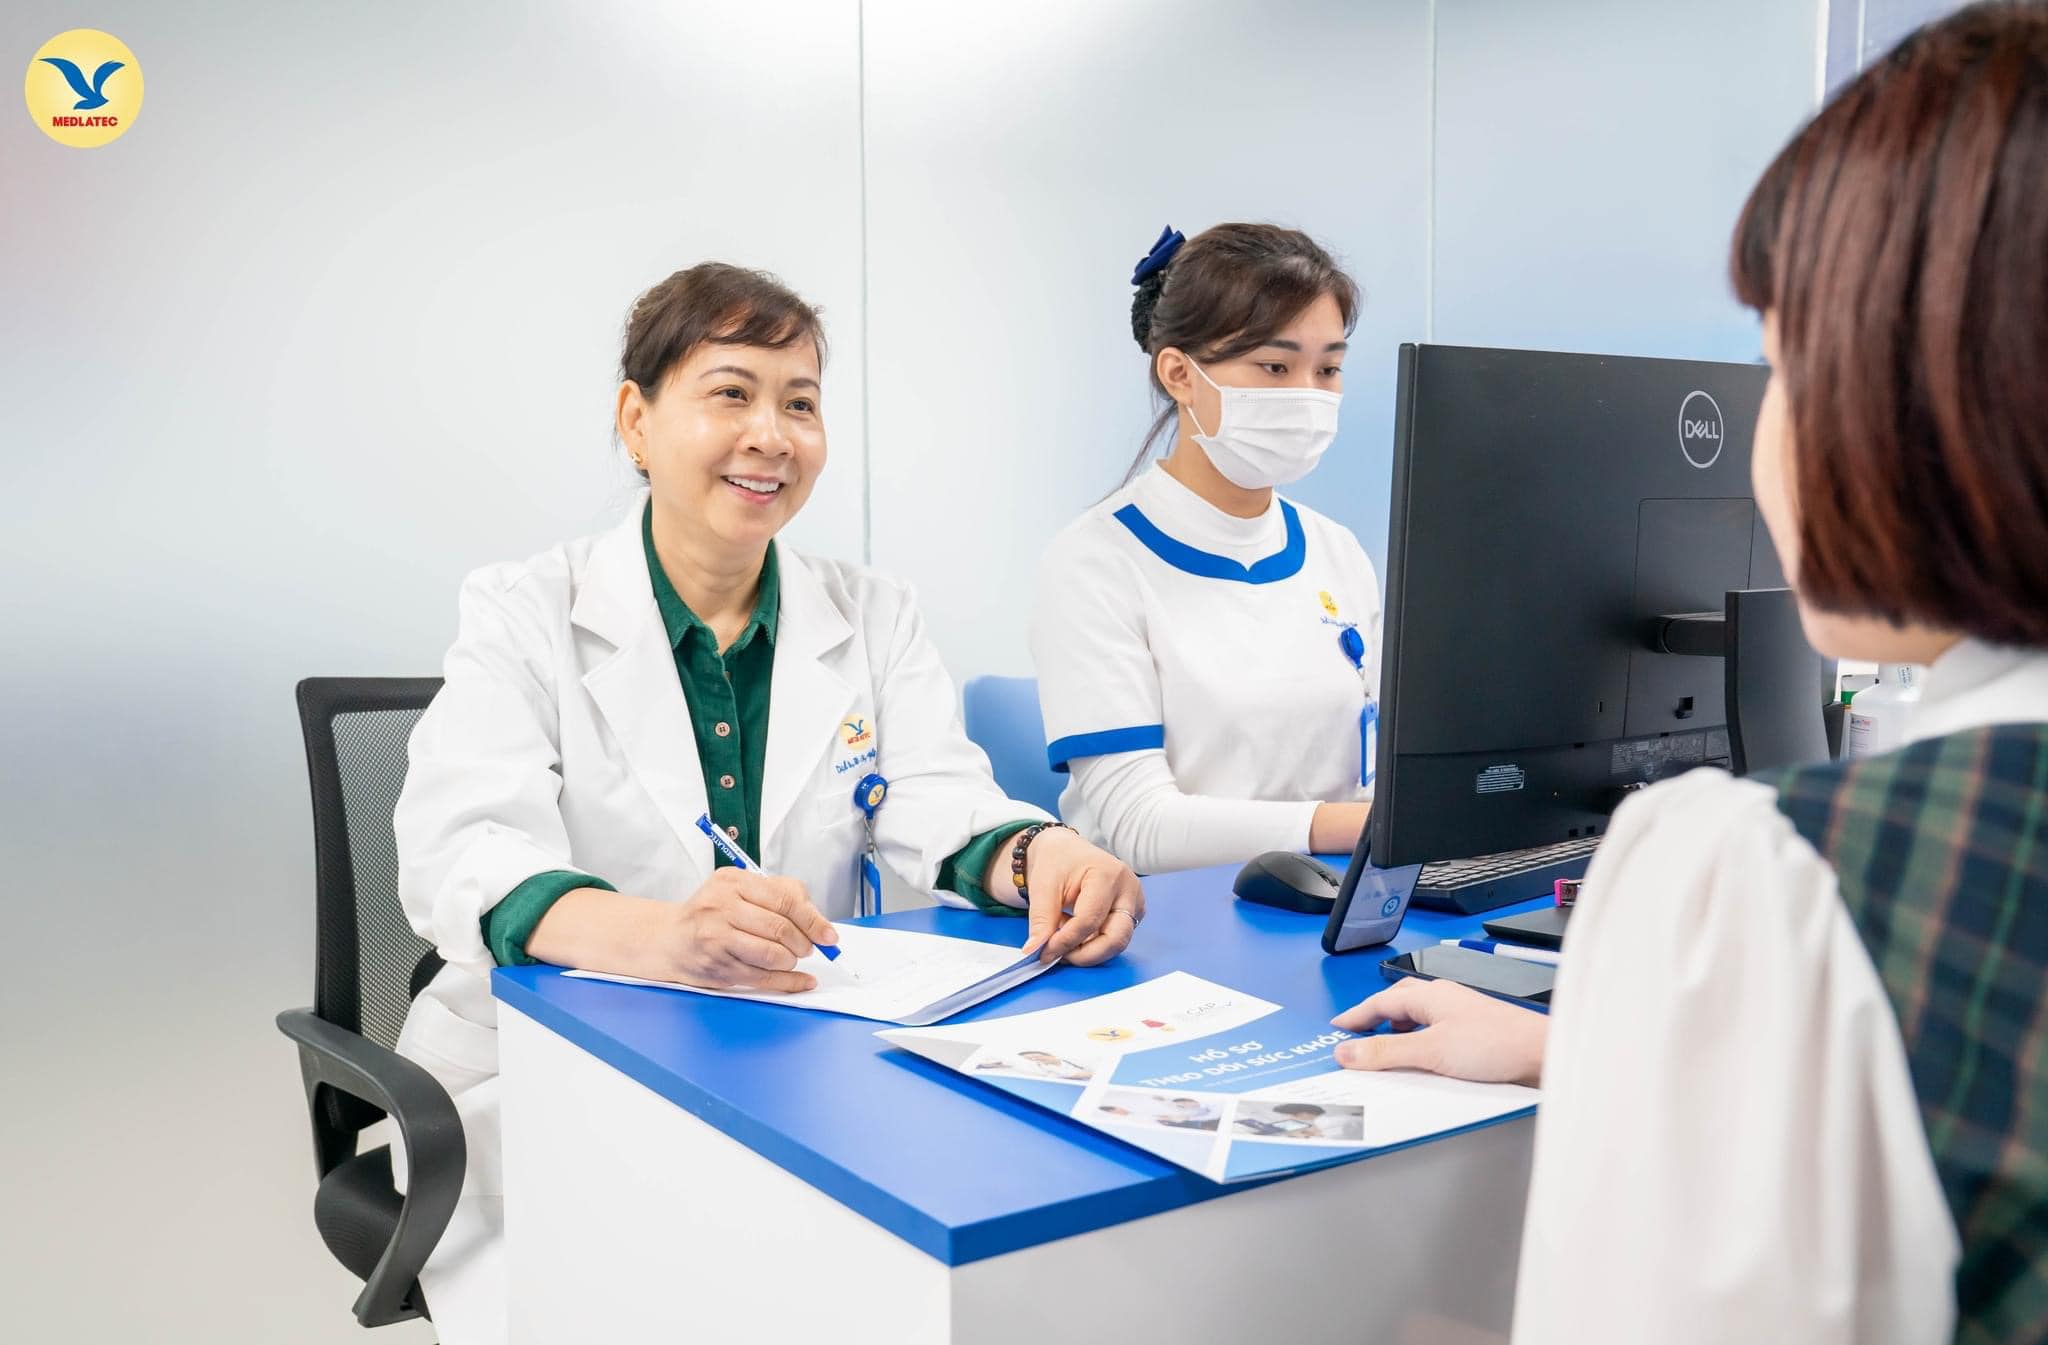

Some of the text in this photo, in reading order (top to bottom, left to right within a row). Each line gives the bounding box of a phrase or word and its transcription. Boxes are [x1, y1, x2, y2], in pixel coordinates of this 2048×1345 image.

[1684, 419, 1720, 439] DELL
[709, 831, 737, 861] MEDLATEC
[1228, 1040, 1264, 1055] SƠ
[1140, 1072, 1203, 1087] THEO
